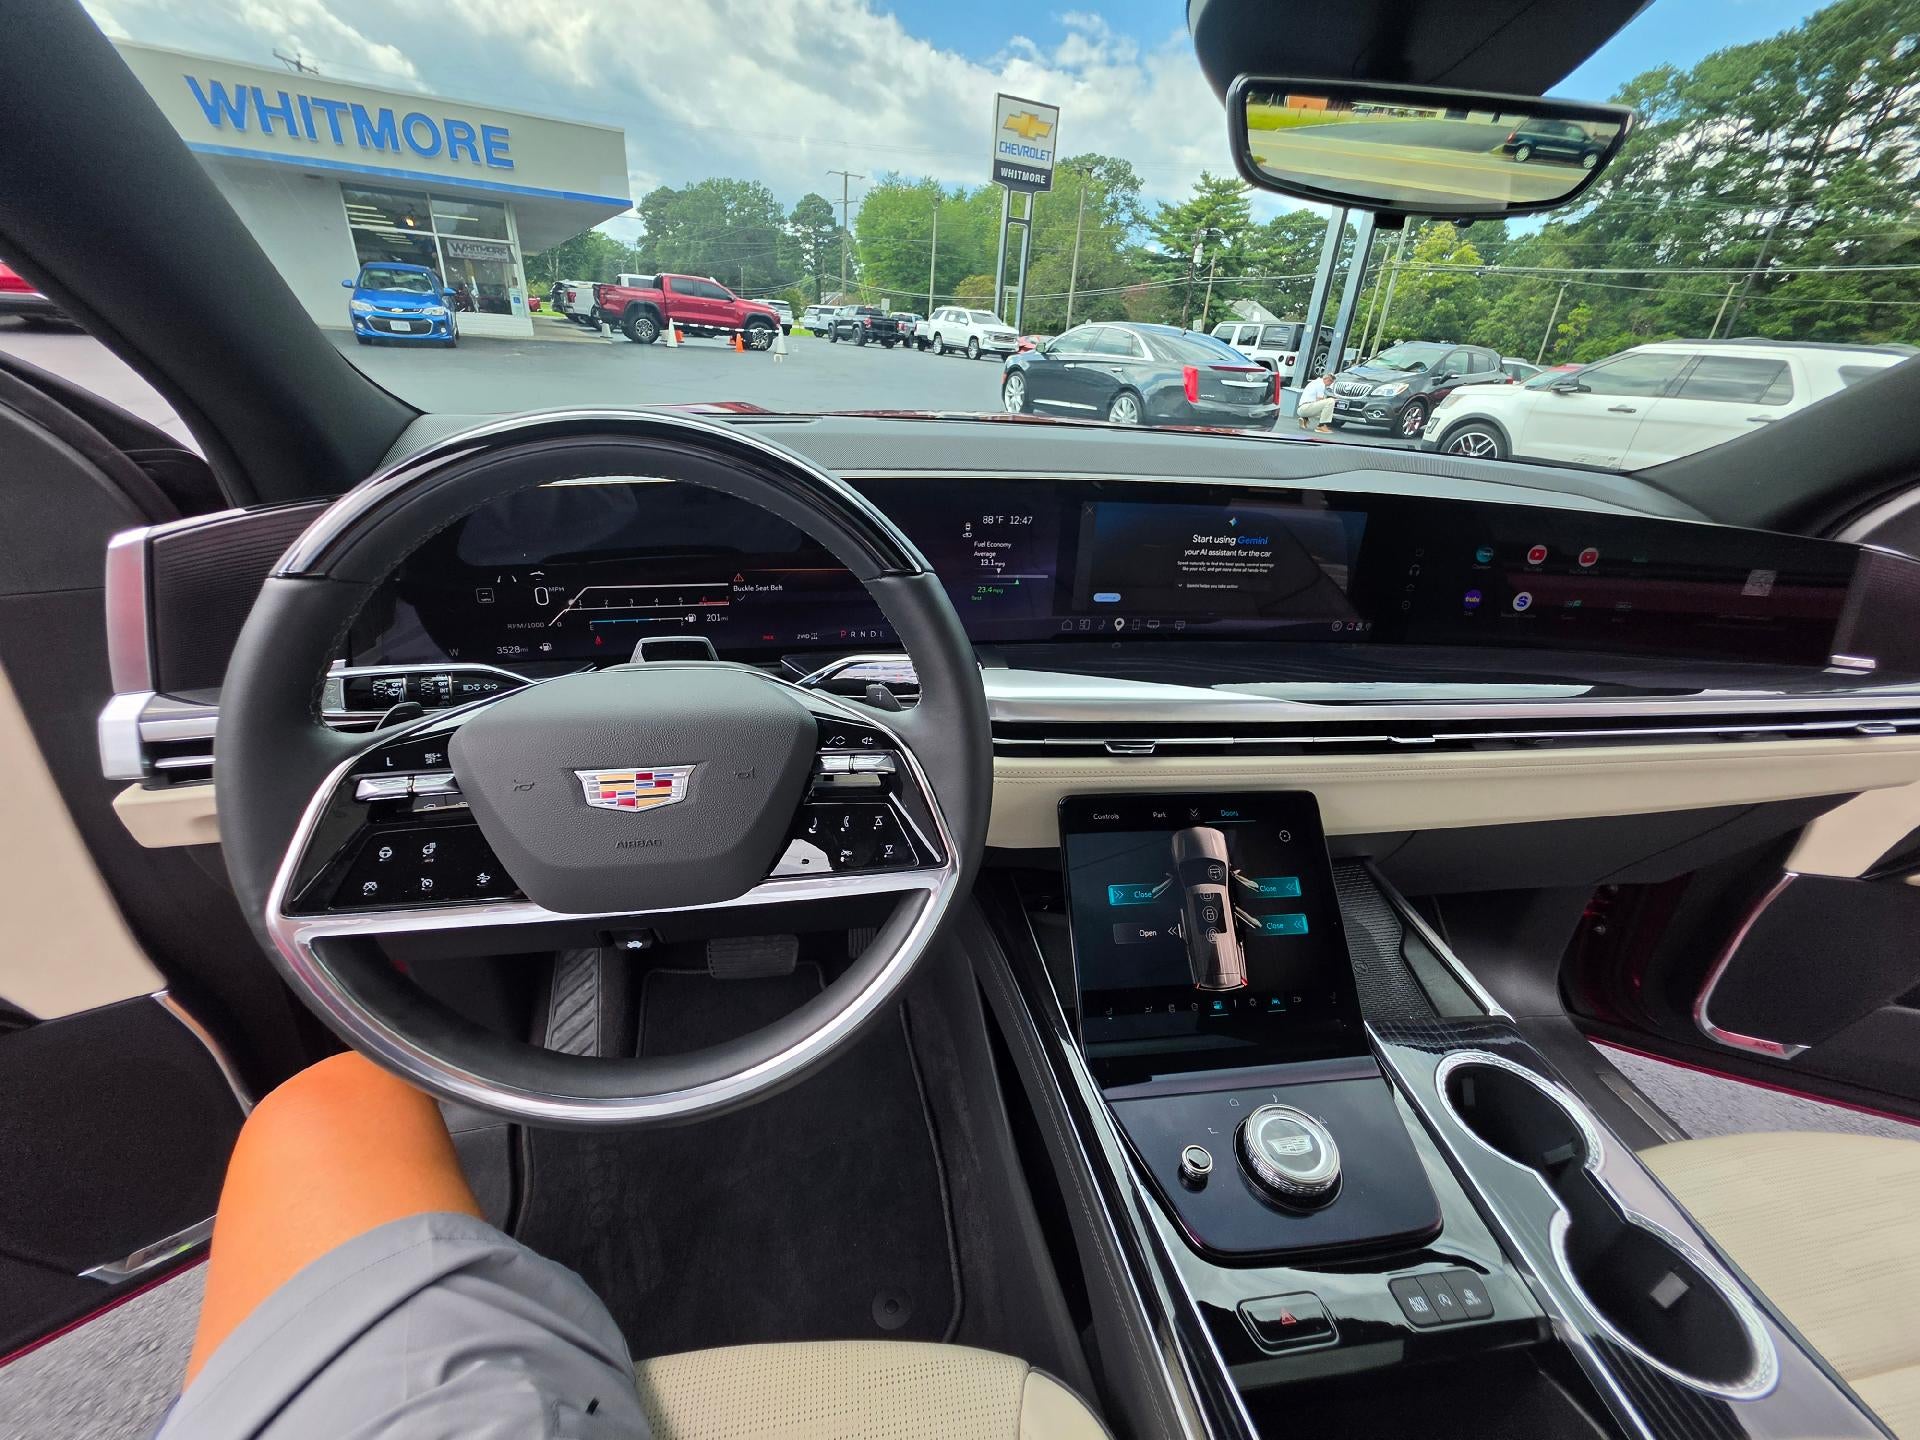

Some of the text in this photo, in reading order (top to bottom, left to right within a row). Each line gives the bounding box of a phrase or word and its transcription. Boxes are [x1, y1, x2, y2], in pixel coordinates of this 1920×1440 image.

[183, 74, 515, 169] WHITMORE
[999, 141, 1052, 161] CHEVROLET
[1000, 167, 1046, 184] WHITMORE
[1010, 515, 1033, 525] 12:47
[1192, 534, 1269, 546] Start using Gemini
[986, 541, 1012, 549] Economy
[973, 551, 997, 559] Average
[1184, 549, 1200, 557] your
[1208, 549, 1237, 557] assistant
[1093, 812, 1120, 821] Controls
[1152, 811, 1167, 819] Park
[1220, 809, 1239, 817] Doors
[1259, 884, 1277, 893] Close
[1133, 890, 1153, 899] Close
[1266, 921, 1284, 930] Close
[1139, 928, 1157, 938] Open
